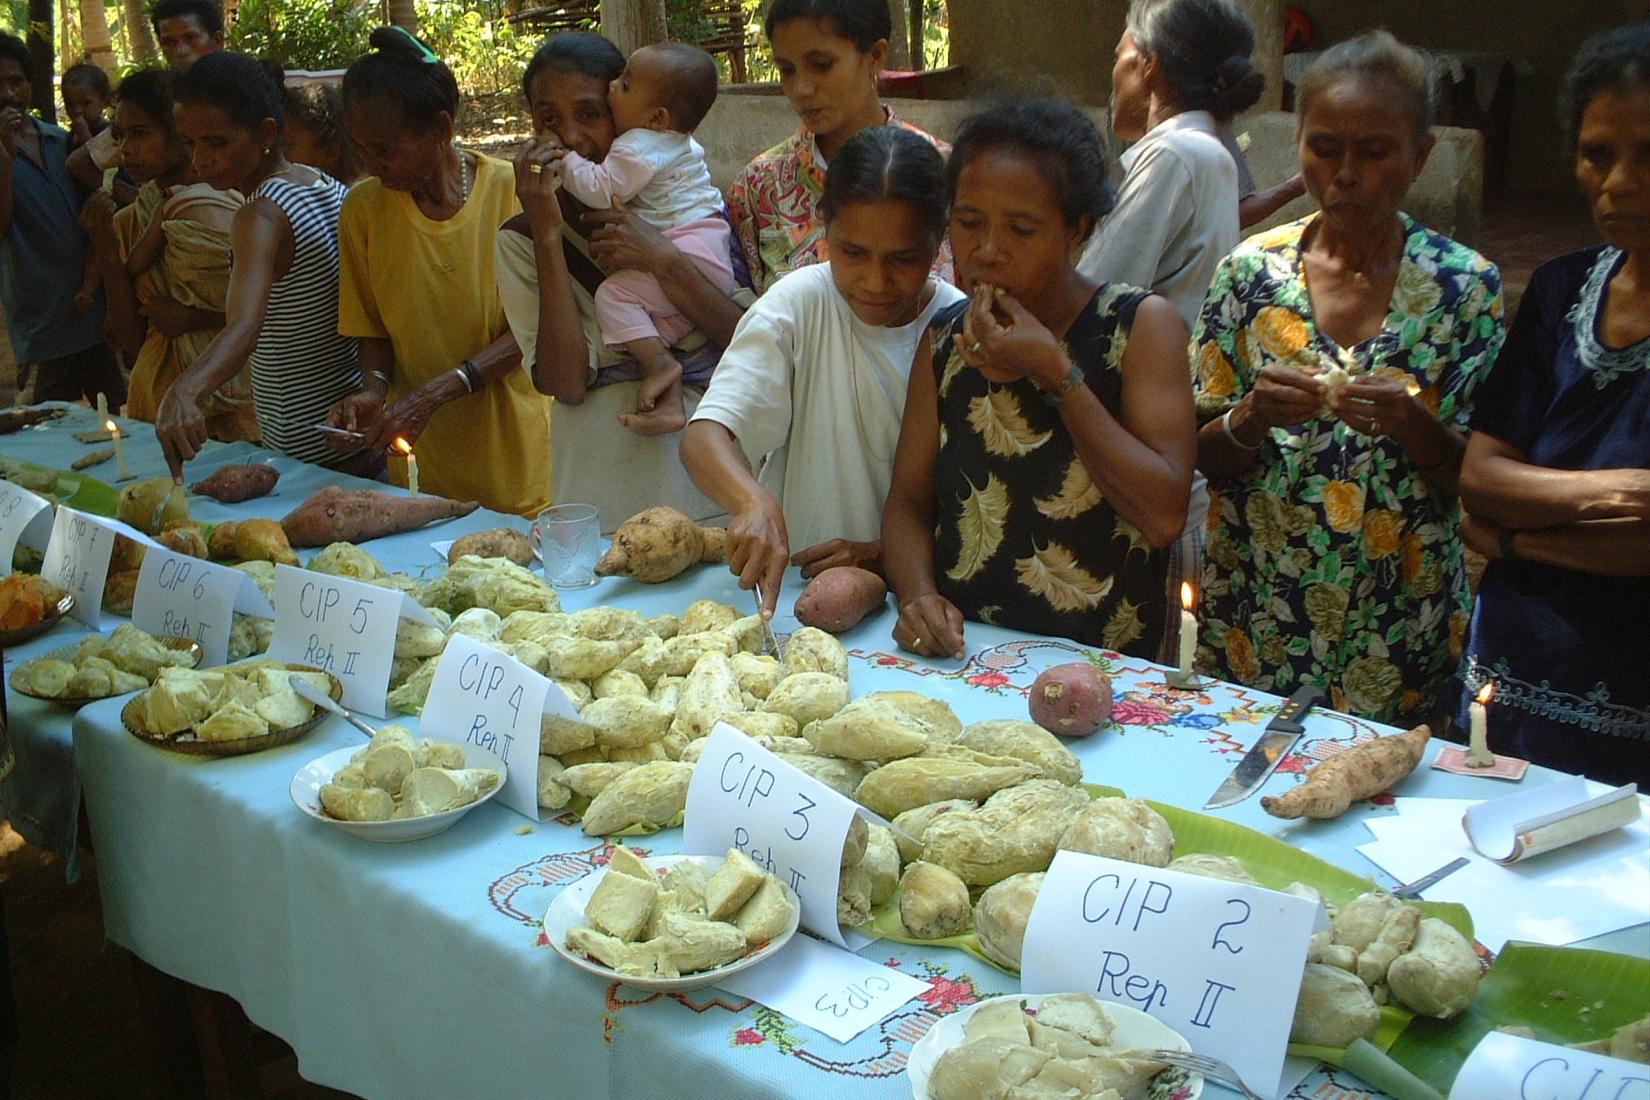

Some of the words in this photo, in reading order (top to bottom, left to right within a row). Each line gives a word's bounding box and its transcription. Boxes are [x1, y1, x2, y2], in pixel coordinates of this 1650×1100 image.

[2, 496, 22, 518] 8
[68, 518, 87, 545] CIP
[89, 527, 100, 552] 7
[158, 558, 192, 592] CIP
[193, 571, 211, 601] 6
[300, 582, 341, 622] CIP
[349, 598, 374, 634] 5
[195, 622, 212, 645] II
[341, 651, 361, 676] II
[459, 653, 505, 700] CIP
[508, 684, 524, 729] 4
[720, 752, 775, 808] CIP
[784, 792, 816, 841] 3
[1082, 873, 1173, 931] CIP
[1212, 899, 1252, 954] 2
[1097, 950, 1167, 1013] Rep
[1190, 979, 1236, 1028] II
